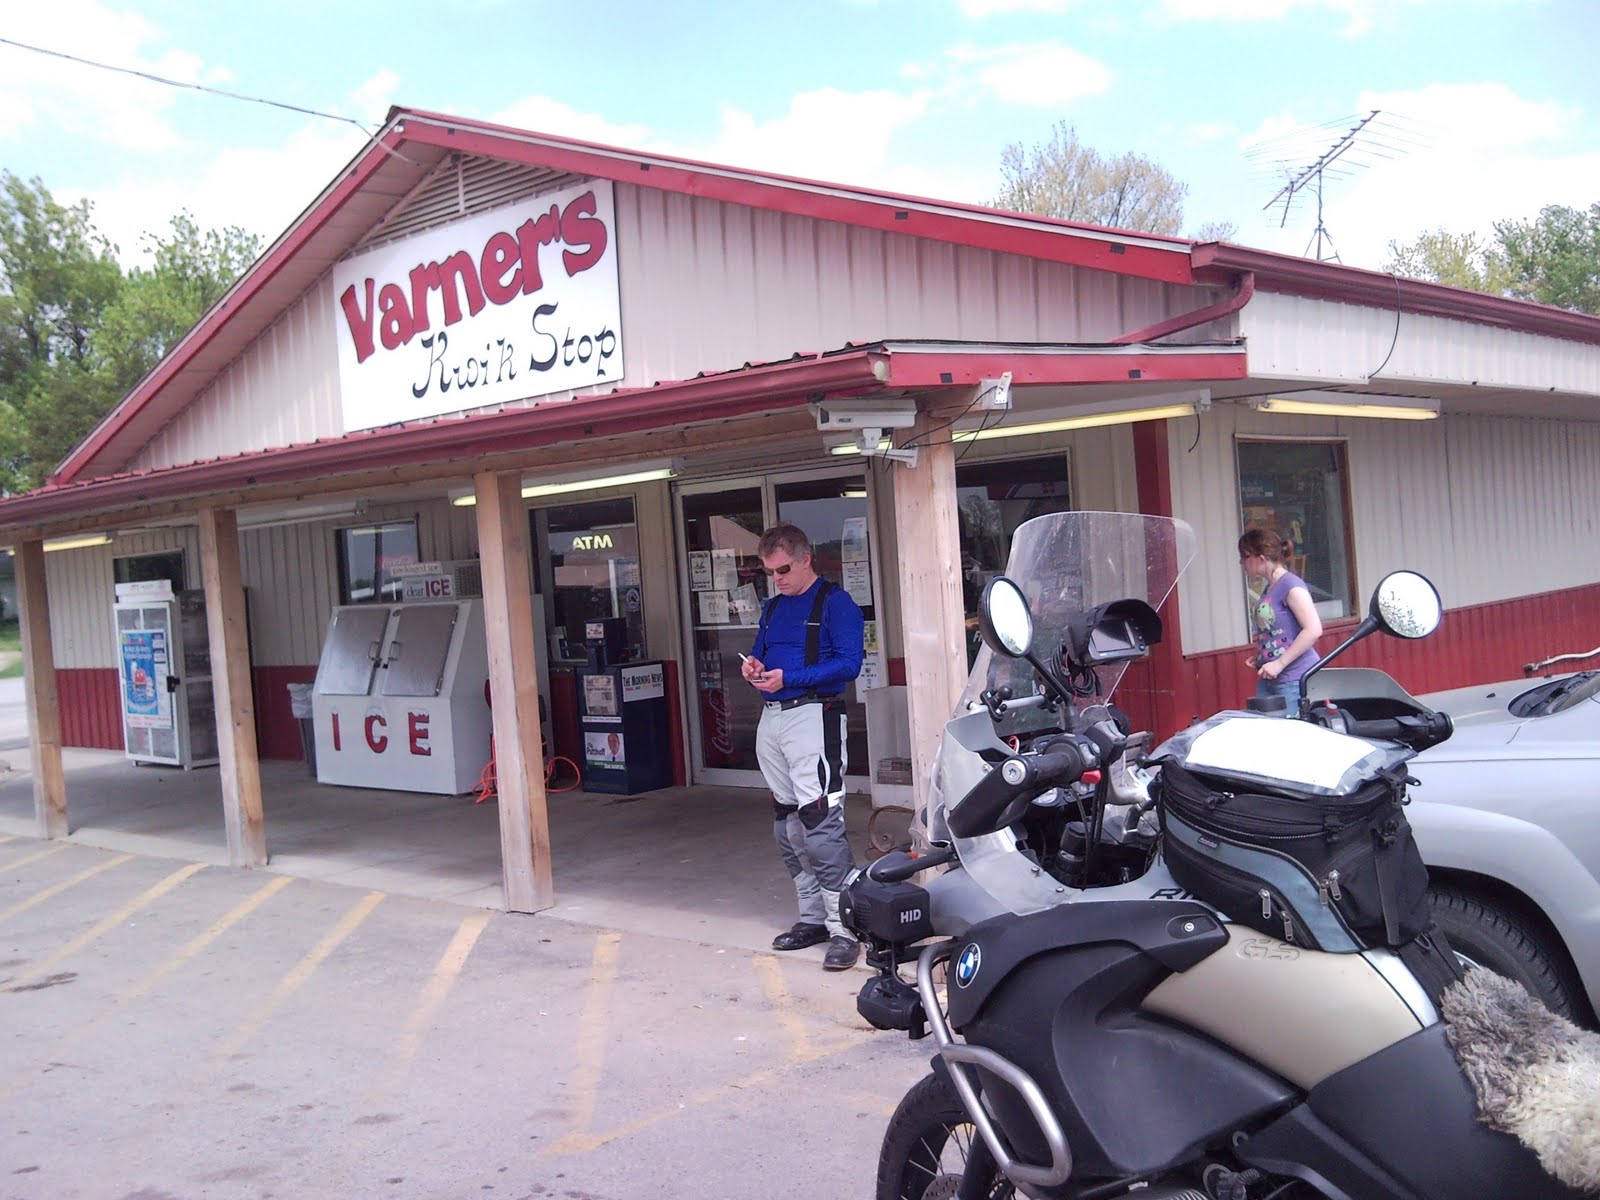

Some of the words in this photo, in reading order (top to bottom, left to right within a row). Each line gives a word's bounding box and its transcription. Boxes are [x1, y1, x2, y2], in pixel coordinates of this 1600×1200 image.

[340, 191, 607, 364] Varner's
[412, 331, 517, 398] Kwik
[529, 301, 616, 376] Stop
[572, 534, 613, 551] ATM
[425, 579, 451, 597] ICE
[331, 710, 431, 756] ICE
[900, 909, 922, 924] HID
[1236, 937, 1300, 961] GS
